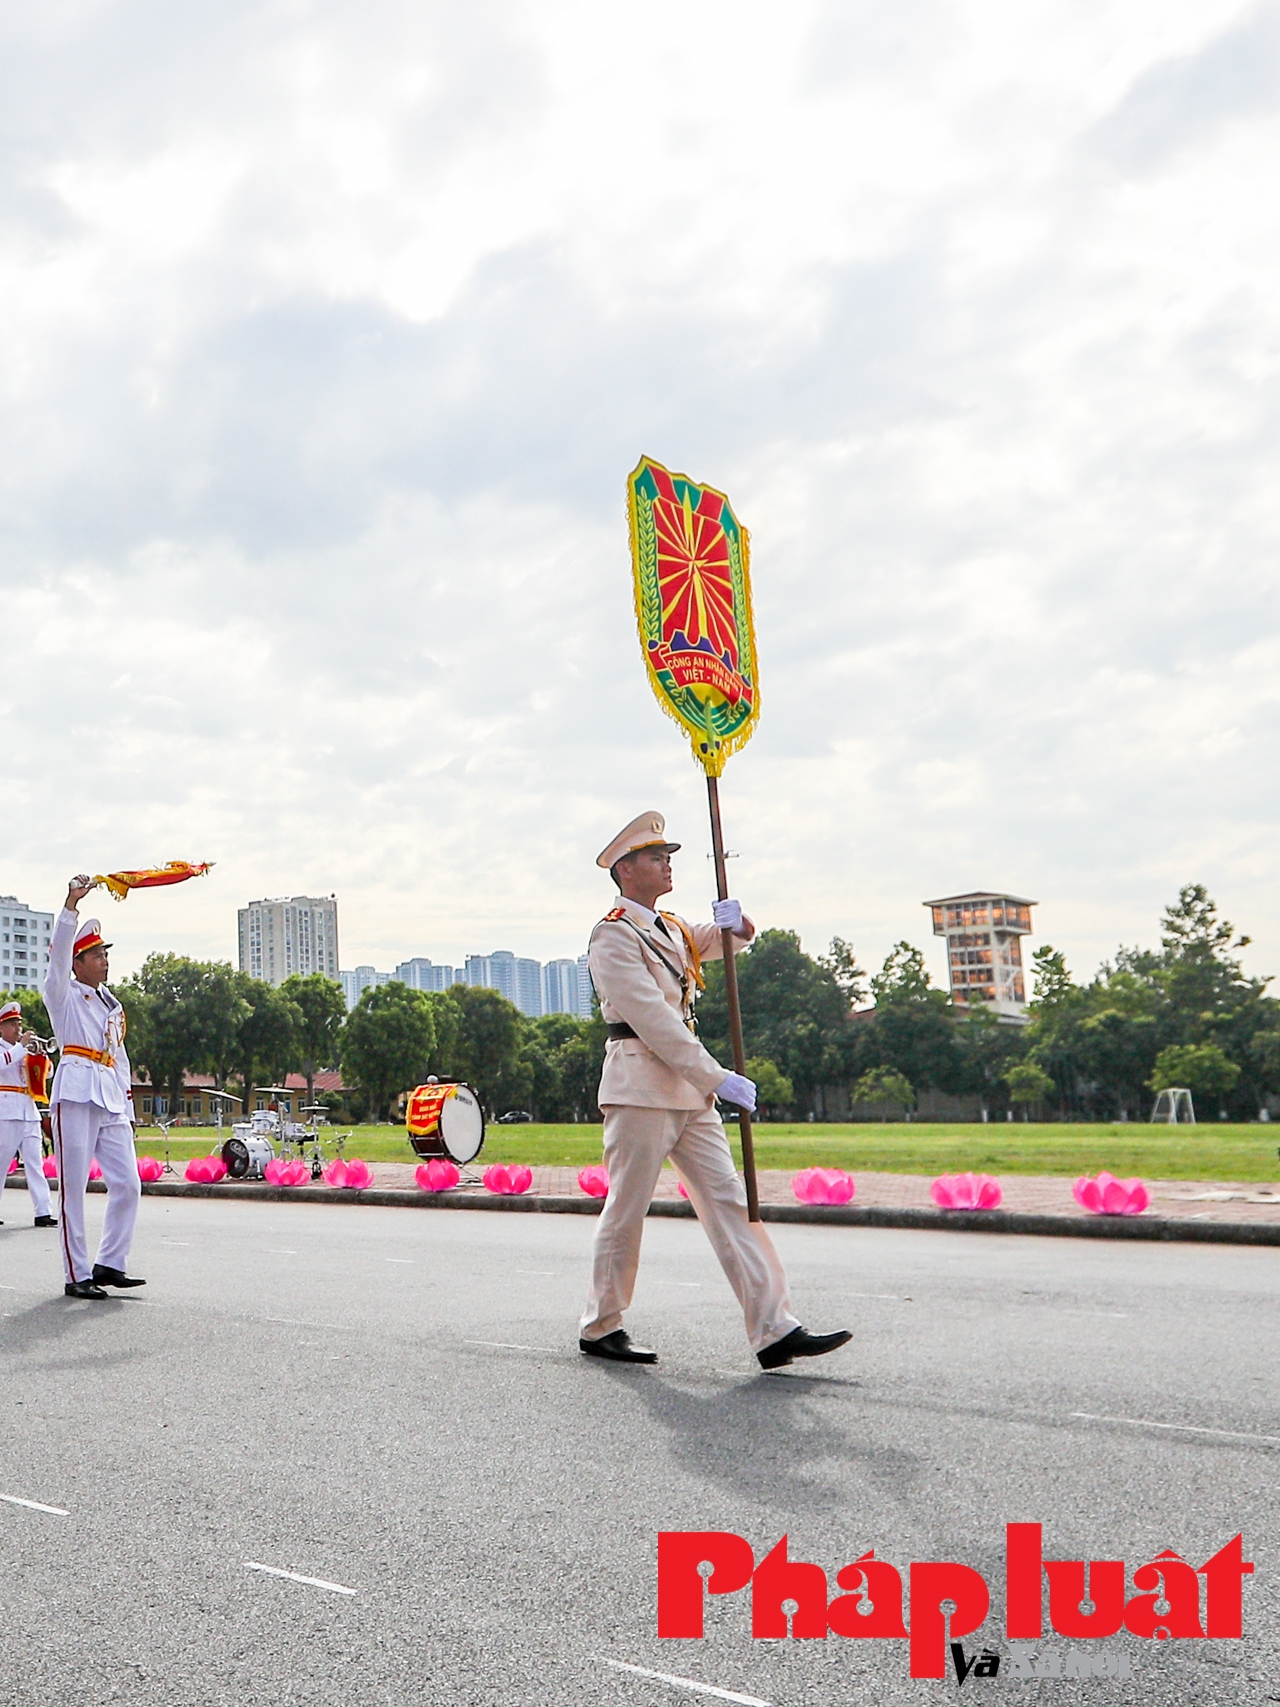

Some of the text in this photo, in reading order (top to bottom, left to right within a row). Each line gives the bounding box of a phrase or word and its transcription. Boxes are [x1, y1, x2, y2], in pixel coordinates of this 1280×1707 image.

[668, 656, 691, 670] CÔNG
[693, 656, 705, 668] AN
[683, 665, 704, 683] VIỆT
[712, 673, 731, 695] NAM
